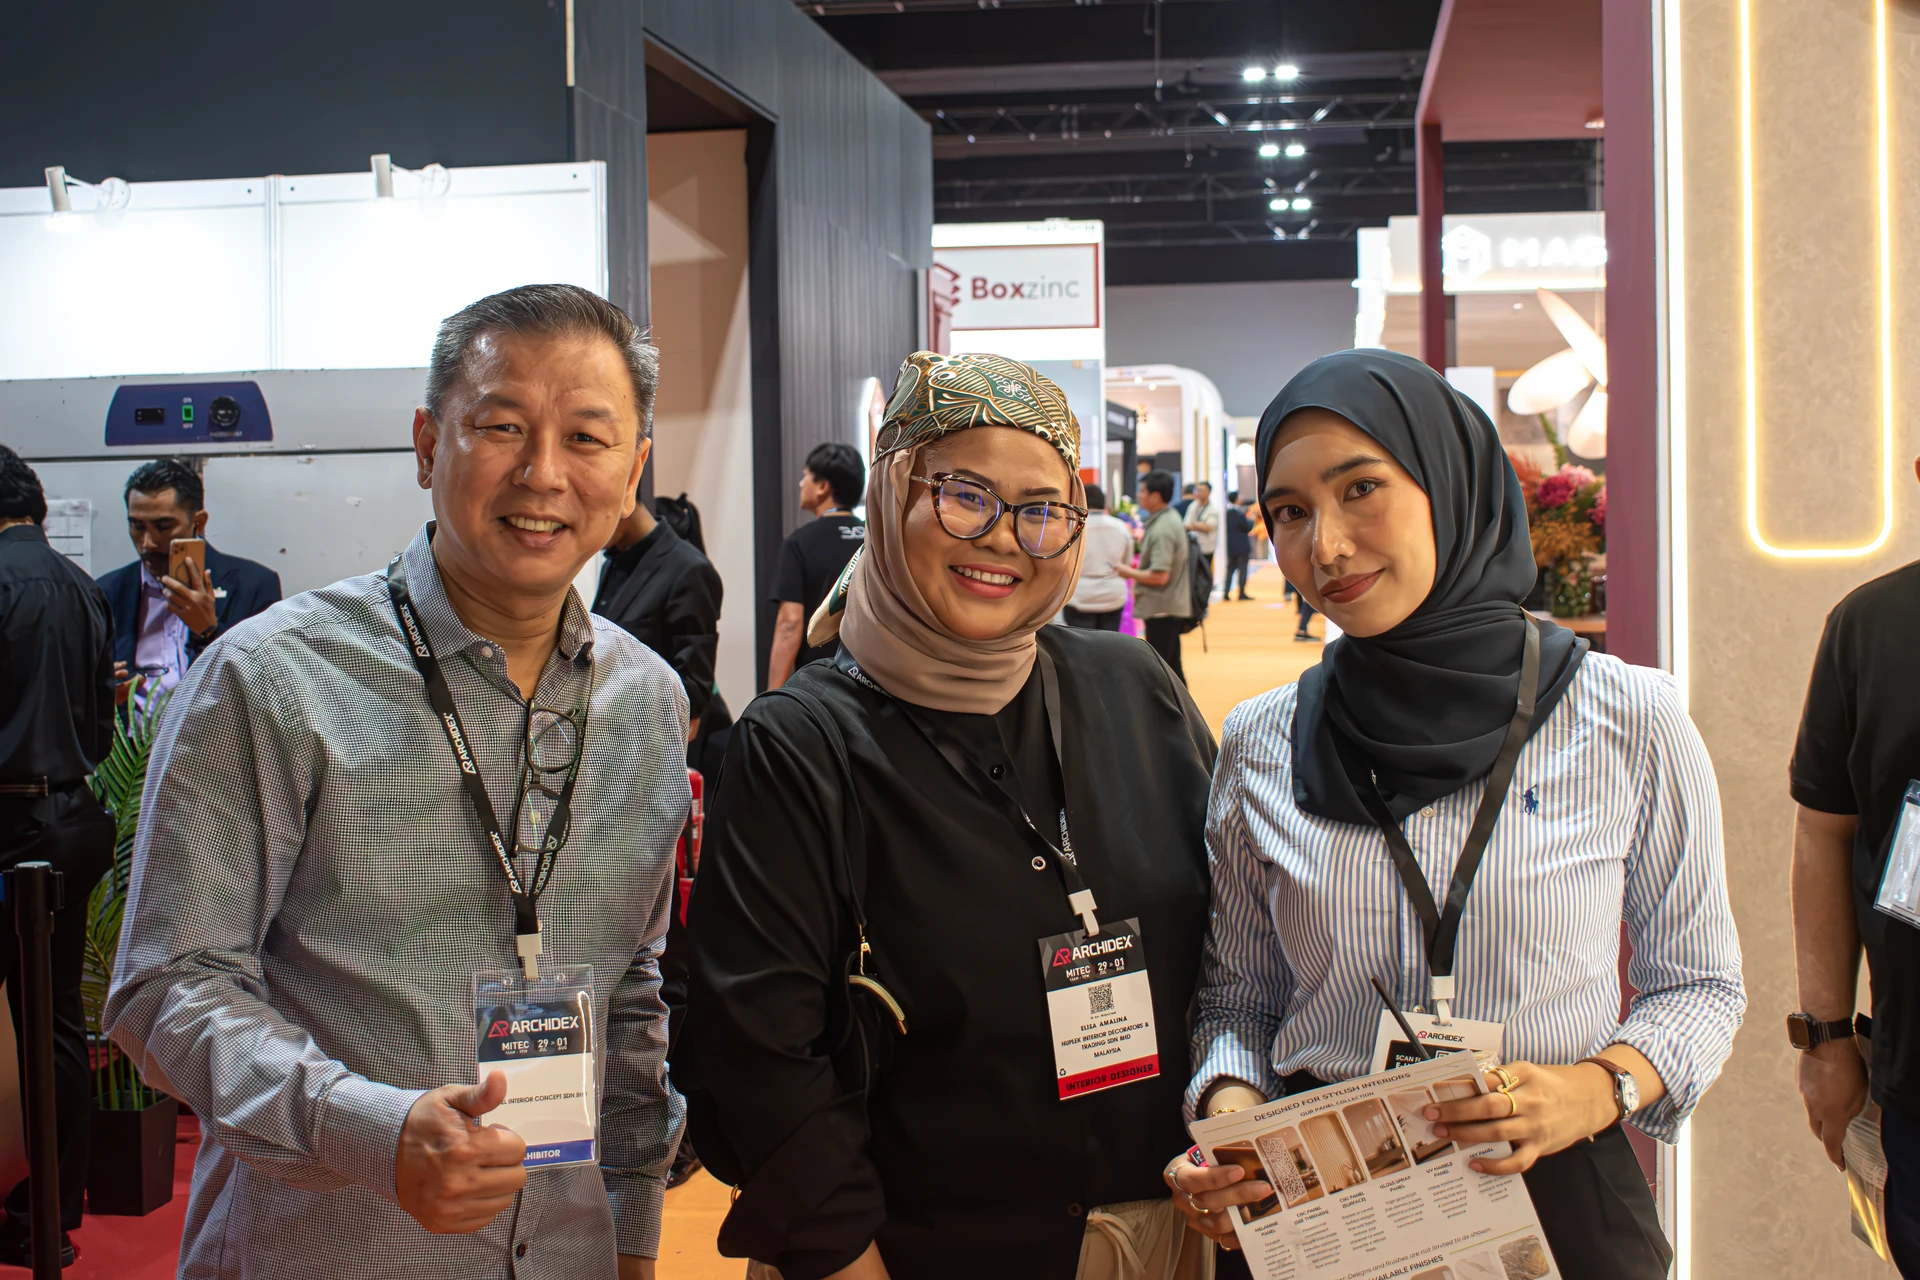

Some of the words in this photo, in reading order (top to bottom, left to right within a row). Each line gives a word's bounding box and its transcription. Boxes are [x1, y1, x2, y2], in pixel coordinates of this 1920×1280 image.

[971, 275, 1080, 299] Boxzinc
[444, 713, 470, 760] ARCHIDEX
[490, 831, 516, 879] ARCHIDEX
[1072, 935, 1133, 961] ARCHIDEX
[1065, 965, 1091, 979] MITEC
[1097, 961, 1108, 971] 29
[1114, 957, 1125, 967] 01
[510, 1016, 579, 1034] ARCHIDEX
[1080, 1023, 1097, 1032] ELISA
[1099, 1016, 1128, 1027] AMALINA
[1082, 1032, 1107, 1042] INTERIOR
[1108, 1023, 1143, 1036] DECORATORS
[501, 1040, 530, 1051] MITEC
[537, 1039, 549, 1048] 29
[556, 1037, 568, 1046] 01
[1081, 1040, 1106, 1050] TRADING
[1107, 1036, 1119, 1044] SDN
[1427, 1032, 1464, 1043] ARCHIDEX
[1093, 1047, 1121, 1058] MALAYSIA
[1395, 1054, 1415, 1063] SCAN
[1065, 1075, 1107, 1091] INTERIOR
[1110, 1063, 1153, 1081] DESIGNER
[508, 1096, 534, 1104] INTERIOR
[534, 1093, 562, 1102] CONCEPT
[1253, 1102, 1300, 1122] DESIGNED
[1301, 1096, 1321, 1106] FOR
[1322, 1085, 1360, 1100] STYLISH
[1361, 1072, 1411, 1089] INTERIORS
[1315, 1103, 1335, 1112] PANEL
[1336, 1091, 1374, 1106] COLLECTION
[1369, 1266, 1409, 1280] VAILABLE
[1409, 1254, 1445, 1271] FINISHES
